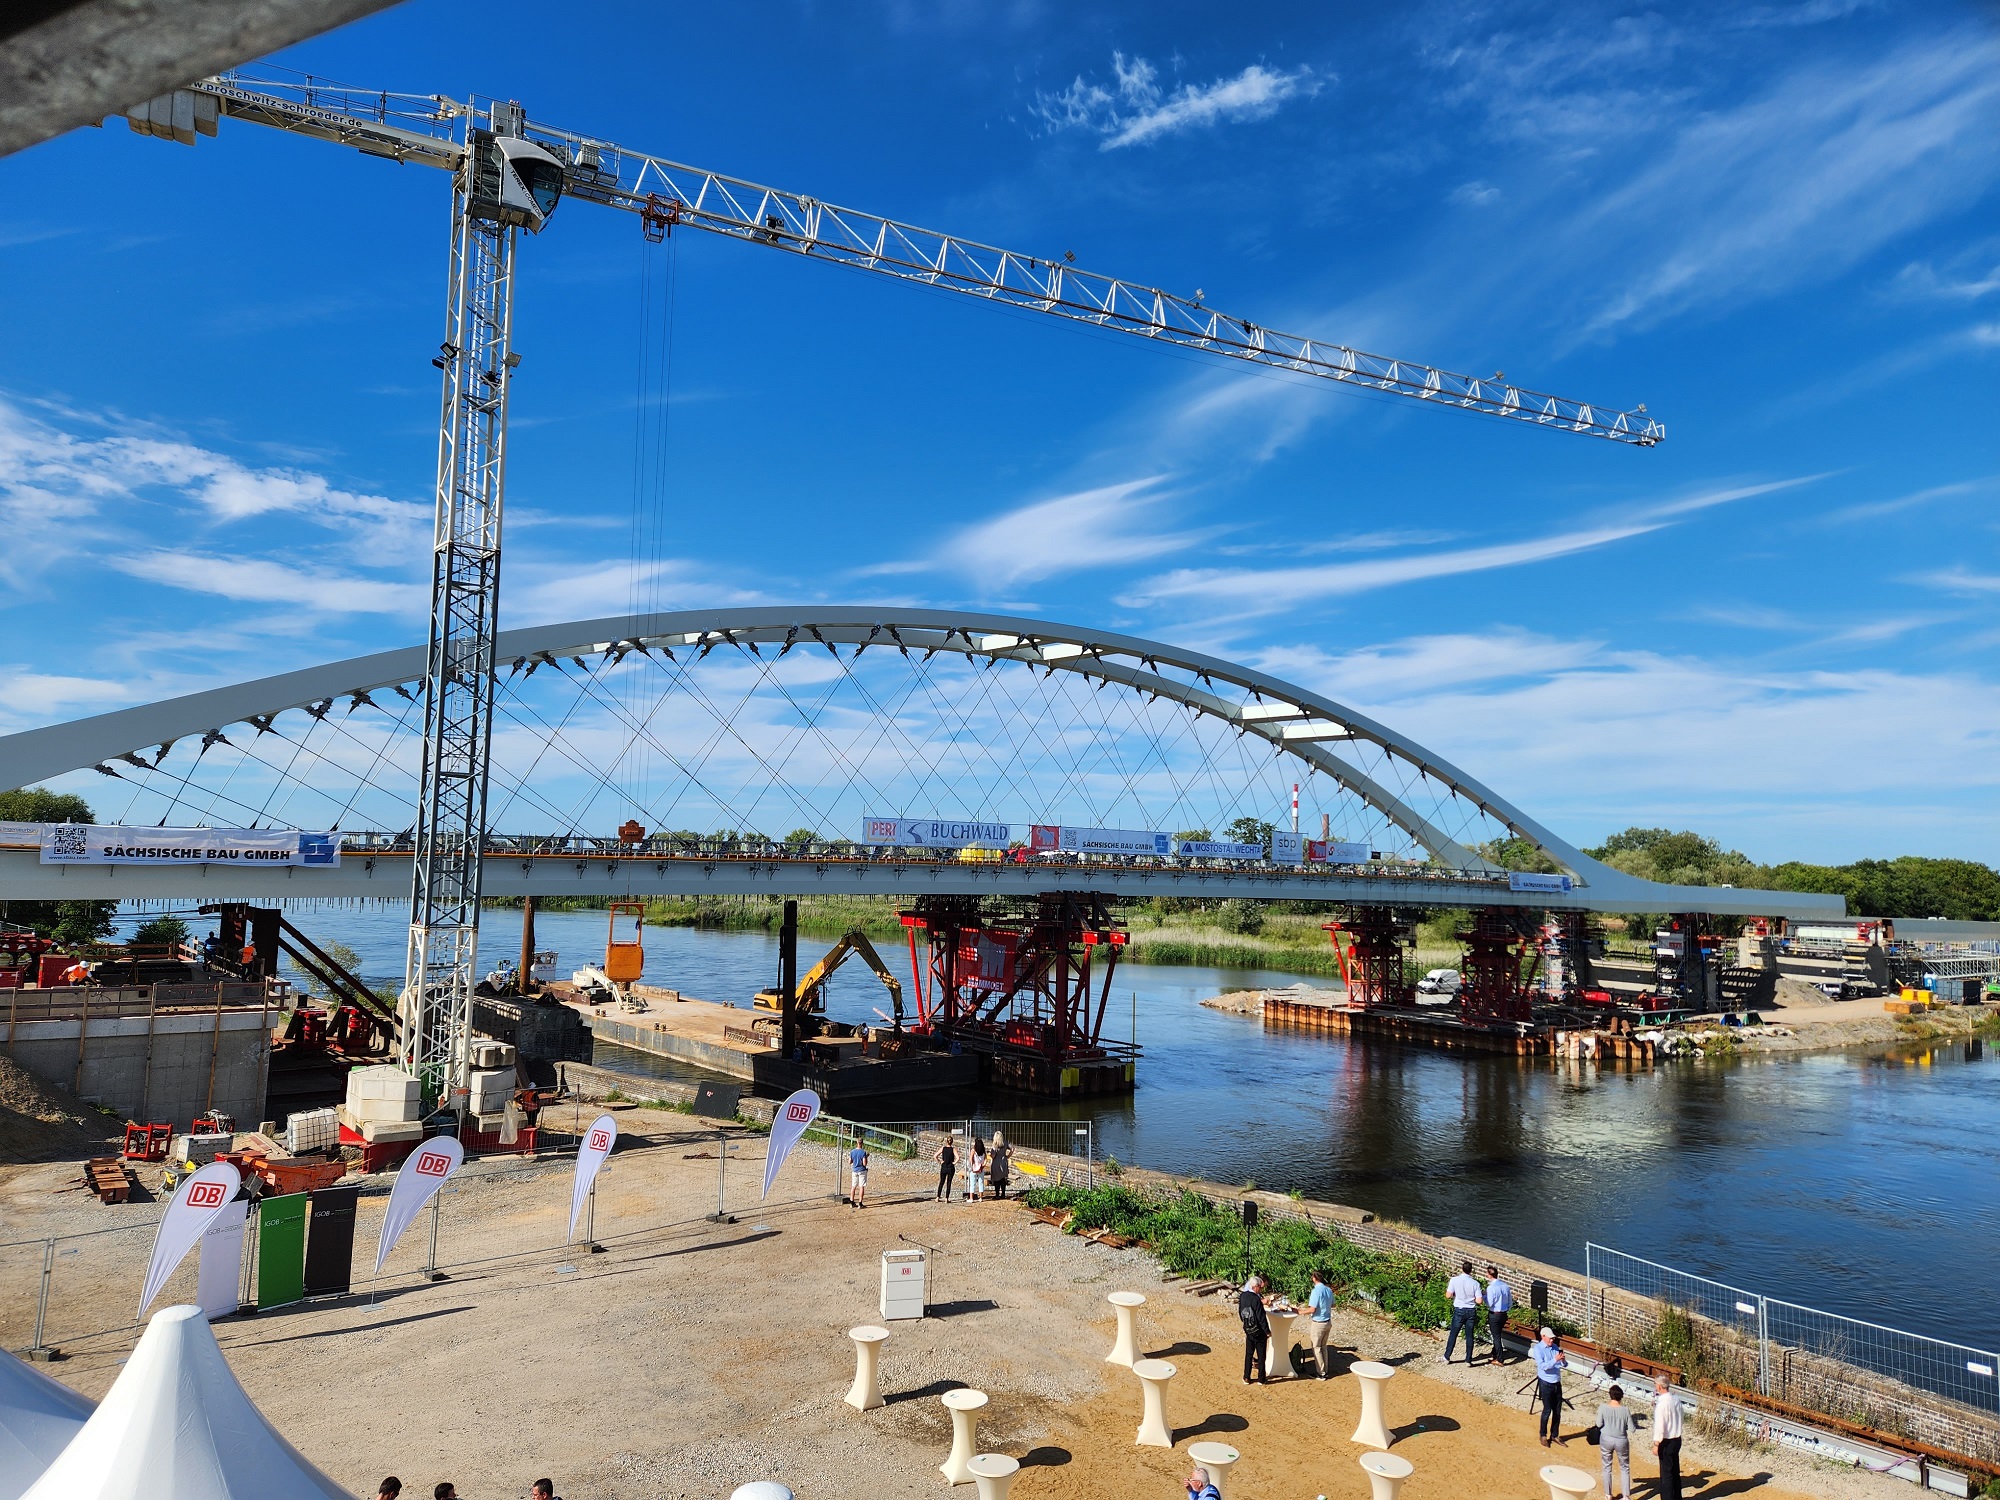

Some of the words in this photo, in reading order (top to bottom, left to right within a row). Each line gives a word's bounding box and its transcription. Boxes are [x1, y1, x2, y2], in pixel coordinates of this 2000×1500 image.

[510, 169, 527, 192] TEREX
[871, 821, 897, 836] PERI
[931, 823, 1008, 840] BUCHWALD
[1082, 840, 1119, 849] SÄCHSISCHE
[1195, 843, 1234, 854] MOSTOSTAL
[1235, 845, 1261, 854] WECHTA
[1278, 835, 1297, 852] sbp
[103, 844, 202, 858] SÄCHSISCHE
[206, 849, 239, 860] BAU
[244, 850, 290, 860] GMBH
[789, 1106, 808, 1119] DB
[592, 1133, 608, 1148] DB
[420, 1156, 445, 1173] DB
[192, 1186, 221, 1204] DB
[314, 1210, 330, 1218] IGOB
[264, 1218, 280, 1228] IGOB
